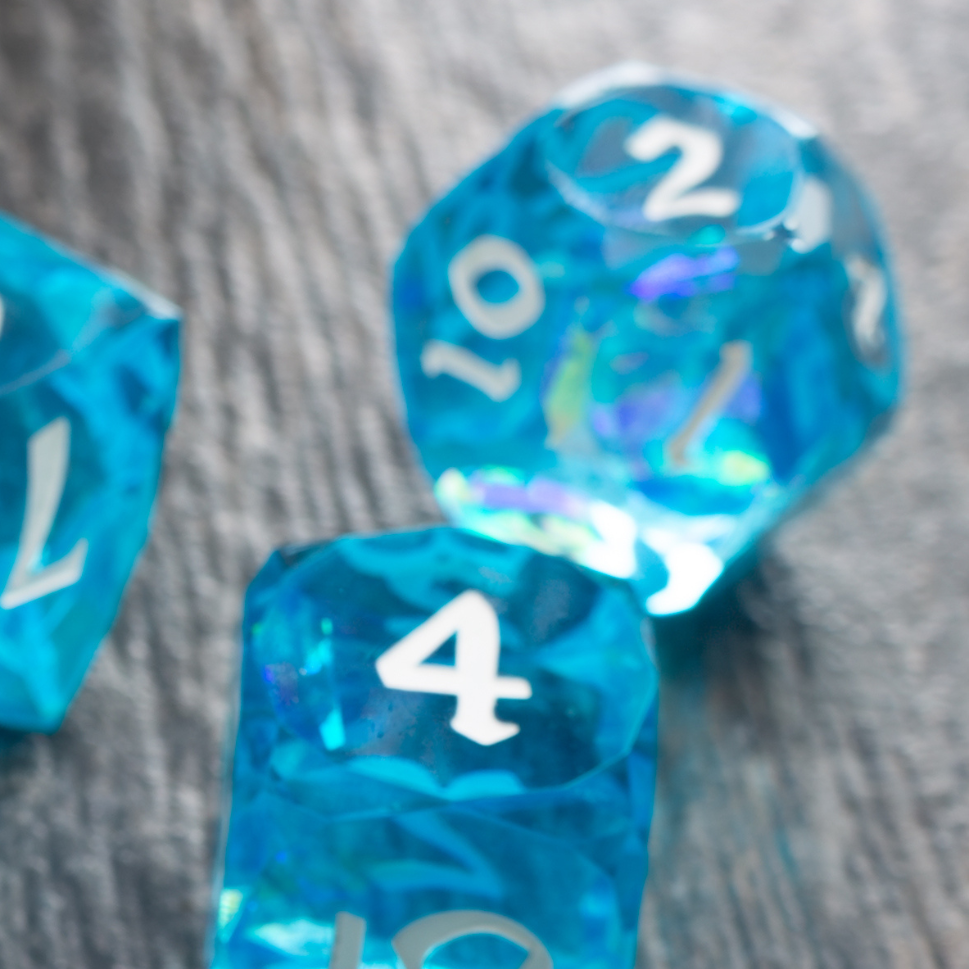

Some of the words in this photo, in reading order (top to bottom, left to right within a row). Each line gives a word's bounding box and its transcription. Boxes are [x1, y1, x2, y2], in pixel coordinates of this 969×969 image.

[624, 115, 740, 223] 2
[422, 234, 547, 403] 10
[0, 415, 88, 610] 7
[375, 589, 531, 746] 4
